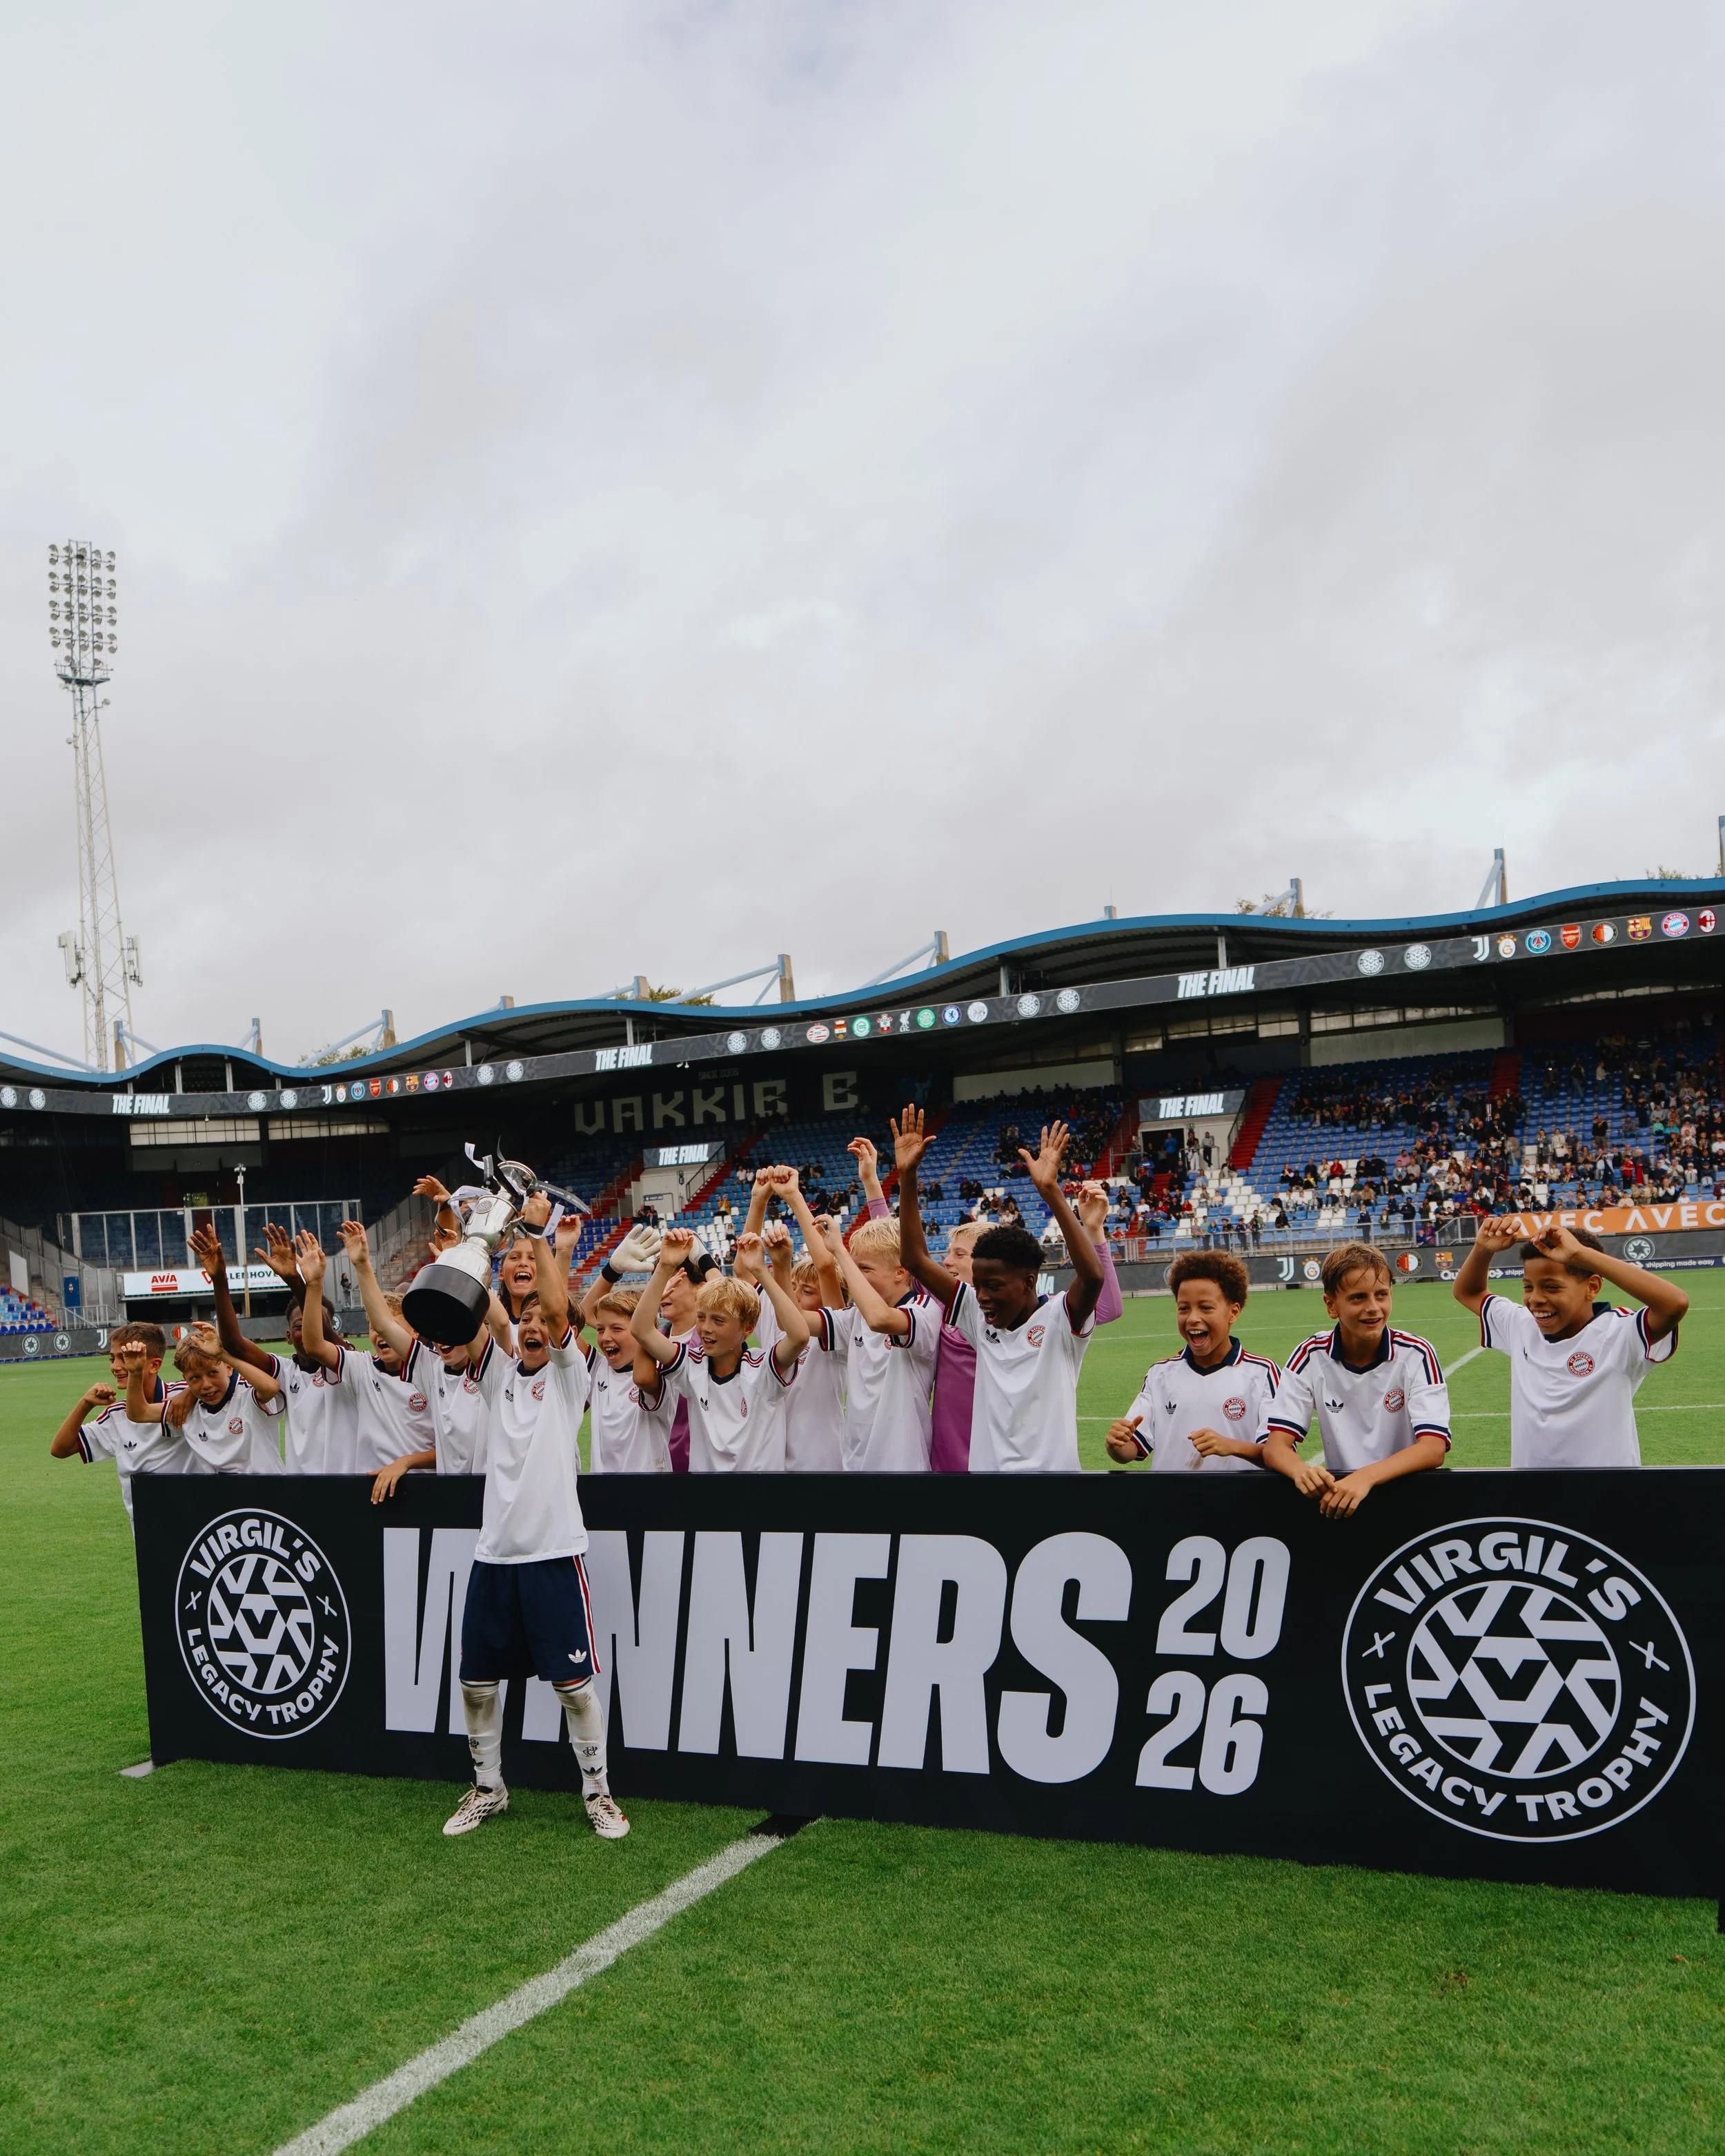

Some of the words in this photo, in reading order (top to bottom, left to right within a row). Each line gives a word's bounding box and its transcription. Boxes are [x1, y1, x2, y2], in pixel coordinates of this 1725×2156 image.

[1177, 972, 1208, 998] THE
[1208, 967, 1254, 994] FINAL
[595, 1048, 618, 1071] THE
[618, 1045, 652, 1068] FINAL
[112, 1095, 133, 1114] THE
[134, 1095, 170, 1114] FINAL
[1159, 1097, 1185, 1119] THE
[1184, 1094, 1224, 1116] FINAL
[658, 1147, 679, 1166] THE
[678, 1143, 709, 1164] FINAL
[1624, 1203, 1725, 1231] AVEC
[190, 1519, 322, 1582] VIRGIL'S
[1155, 1535, 1291, 1659] 20
[1373, 1531, 1642, 1621] VIRGIL'S
[187, 1628, 262, 1721] LEGACY
[266, 1634, 339, 1725] TROPHY
[1135, 1670, 1269, 1795] 26
[1363, 1683, 1508, 1817] LEGACY
[1515, 1696, 1670, 1822] TROPHY
